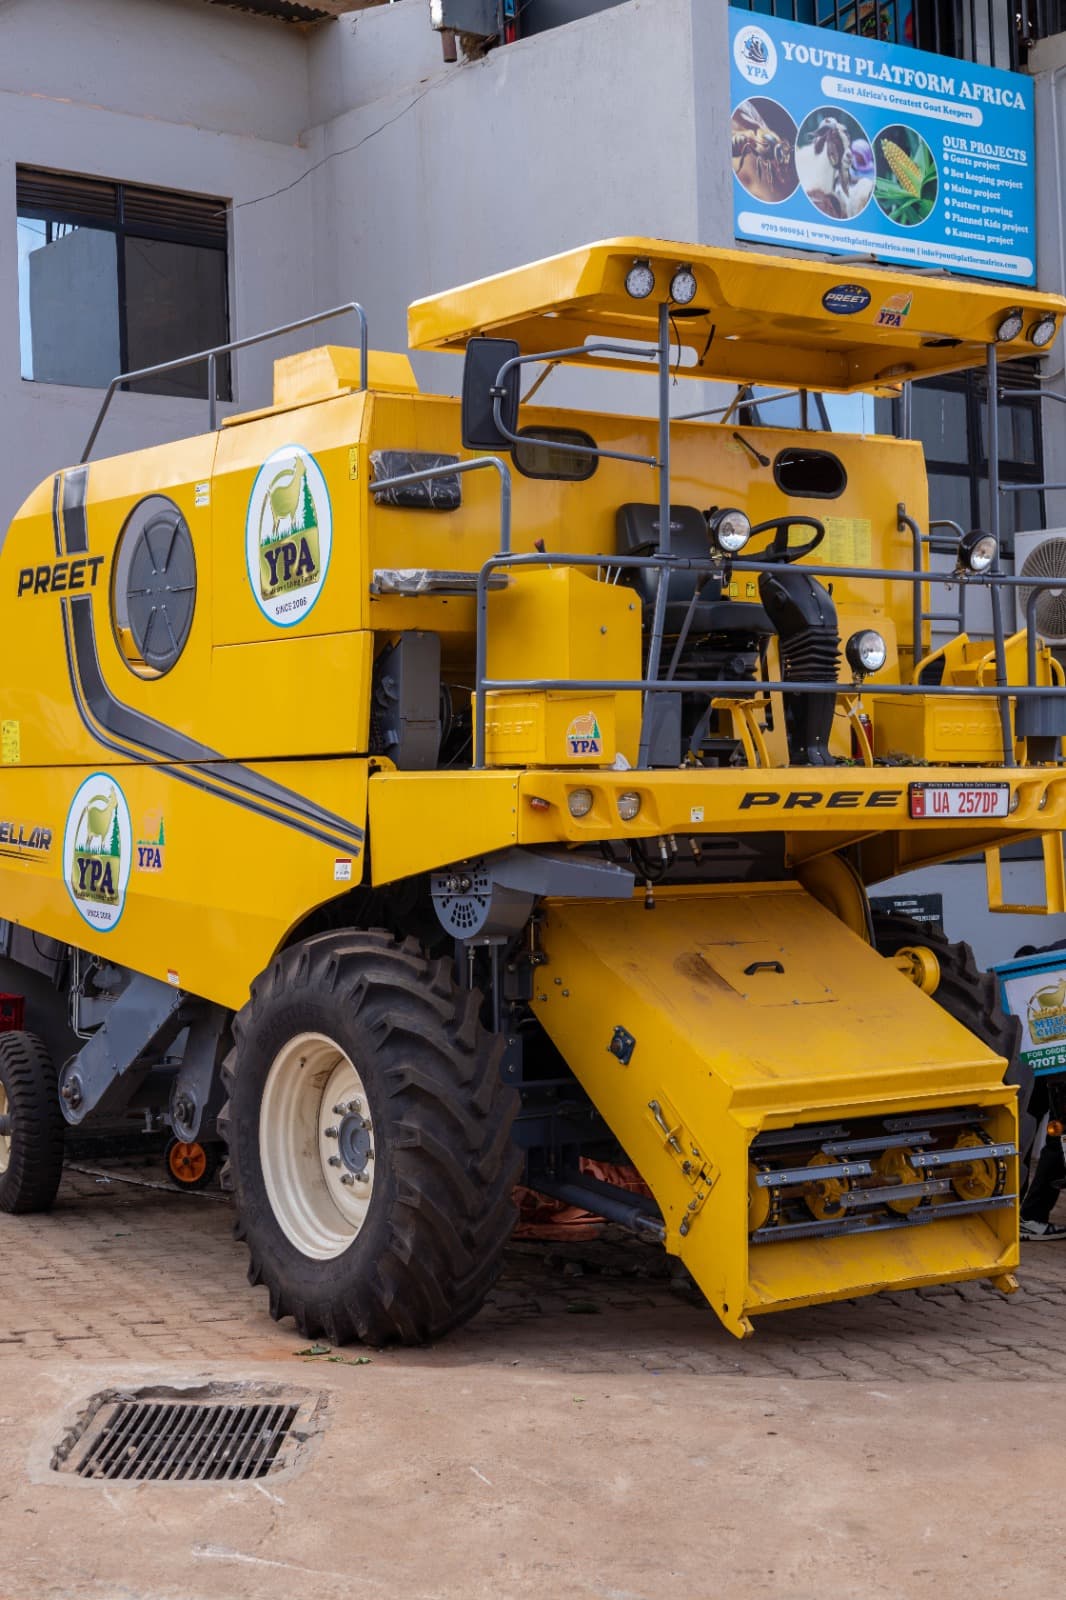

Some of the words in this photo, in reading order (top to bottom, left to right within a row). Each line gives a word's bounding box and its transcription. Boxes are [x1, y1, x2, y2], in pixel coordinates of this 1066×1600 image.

[746, 65, 769, 79] YPA
[781, 41, 851, 73] YOUTH
[855, 57, 955, 96] PLATFORM
[959, 80, 1026, 110] AFRICA
[837, 83, 855, 95] East
[857, 87, 887, 101] Africa's
[889, 95, 922, 109] Greatest
[923, 102, 941, 113] Goat
[943, 106, 973, 120] Keepers
[943, 136, 968, 150] OUR
[970, 140, 1027, 161] PROJECTS
[973, 160, 1000, 171] project
[966, 171, 995, 185] keeping
[997, 178, 1023, 189] project
[974, 189, 1000, 200] project
[951, 198, 980, 211] Pasture
[982, 205, 1013, 218] growing
[1002, 223, 1029, 234] project
[987, 235, 1014, 245] project
[825, 292, 869, 304] PREET
[878, 312, 902, 327] YPA
[264, 537, 316, 586] YPA
[17, 555, 105, 597] PREET
[570, 739, 600, 753] YPA
[738, 790, 903, 810] PREE
[933, 791, 950, 813] UA
[958, 791, 999, 814] 257DP
[137, 847, 162, 868] YPA
[77, 857, 115, 895] YPA
[1035, 1014, 1066, 1028] MBU
[1027, 1049, 1043, 1059] FOR
[1045, 1046, 1066, 1056] ORDE
[1058, 1054, 1066, 1064] 5
